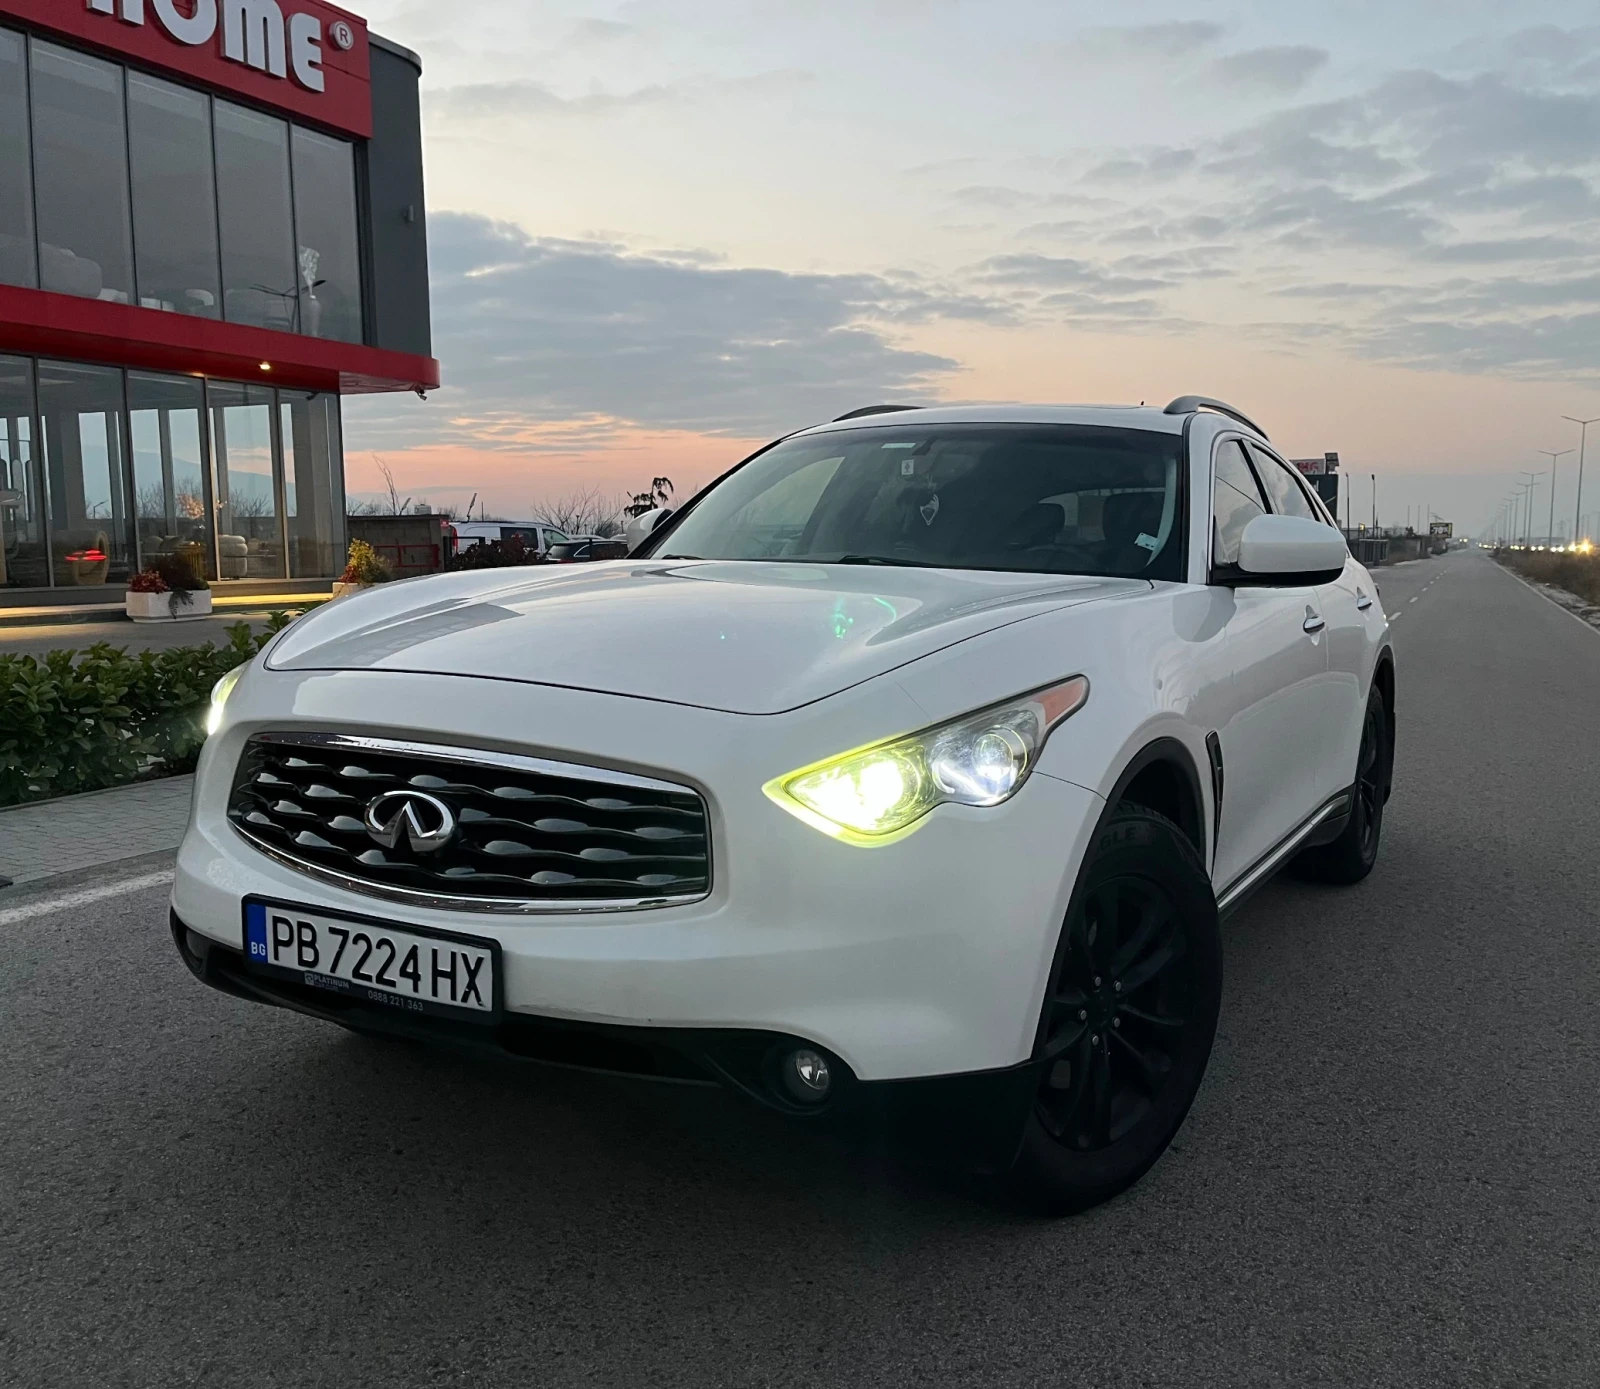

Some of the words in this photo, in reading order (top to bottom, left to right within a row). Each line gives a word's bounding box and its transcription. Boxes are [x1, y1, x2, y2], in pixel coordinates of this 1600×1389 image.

[86, 0, 325, 93] OME
[251, 941, 267, 956] BG
[272, 915, 320, 969] PB
[328, 926, 422, 993] 7224
[431, 948, 486, 1007] HX
[313, 974, 350, 989] PLATINUM
[390, 995, 404, 1008] 221
[407, 999, 424, 1011] 363
